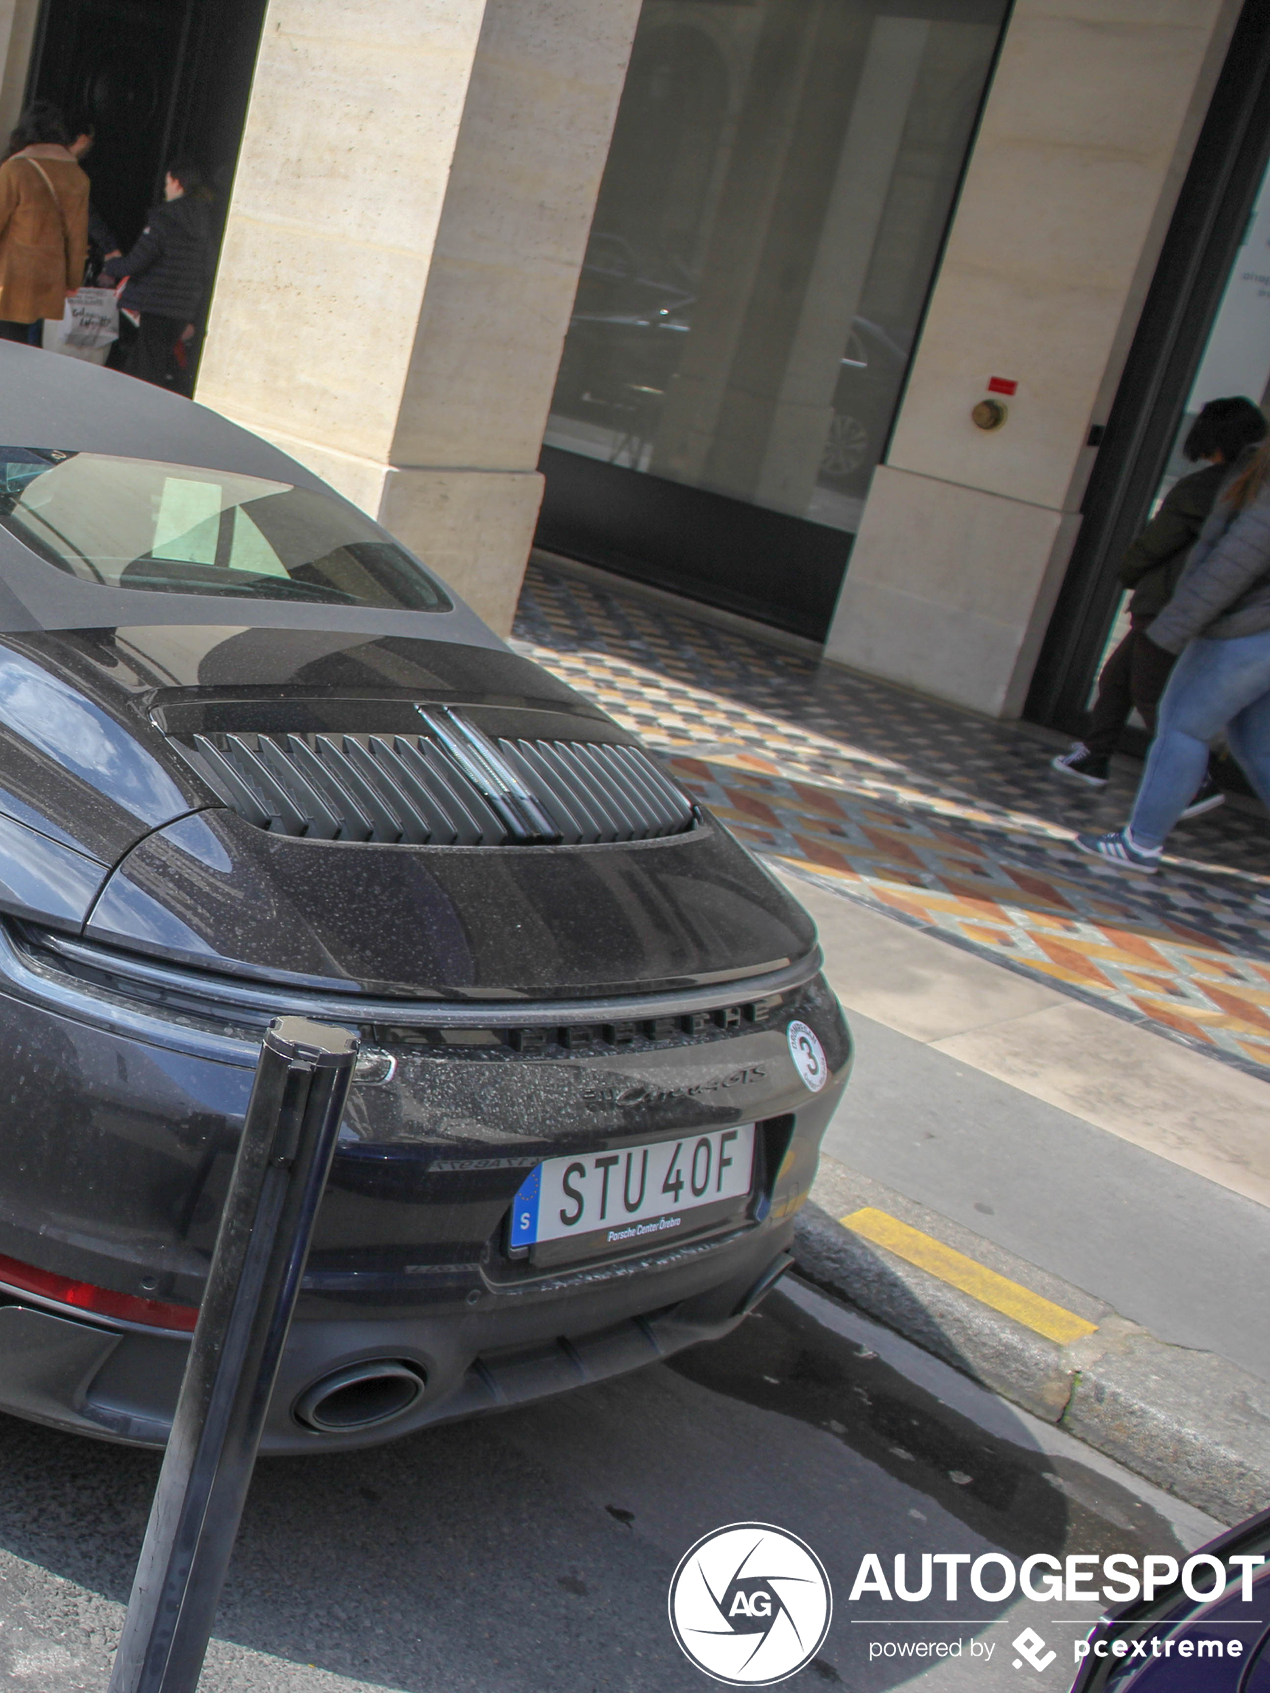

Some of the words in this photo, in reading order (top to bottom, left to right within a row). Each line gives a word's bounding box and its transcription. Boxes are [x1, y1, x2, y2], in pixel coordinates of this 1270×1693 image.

[799, 1037, 820, 1076] 3
[721, 1064, 767, 1088] GTS
[559, 1149, 649, 1226] STU
[662, 1130, 739, 1203] 40F
[520, 1212, 530, 1230] S
[607, 1227, 636, 1242] Porsche
[636, 1222, 659, 1236] Center
[658, 1216, 681, 1230] Örebro
